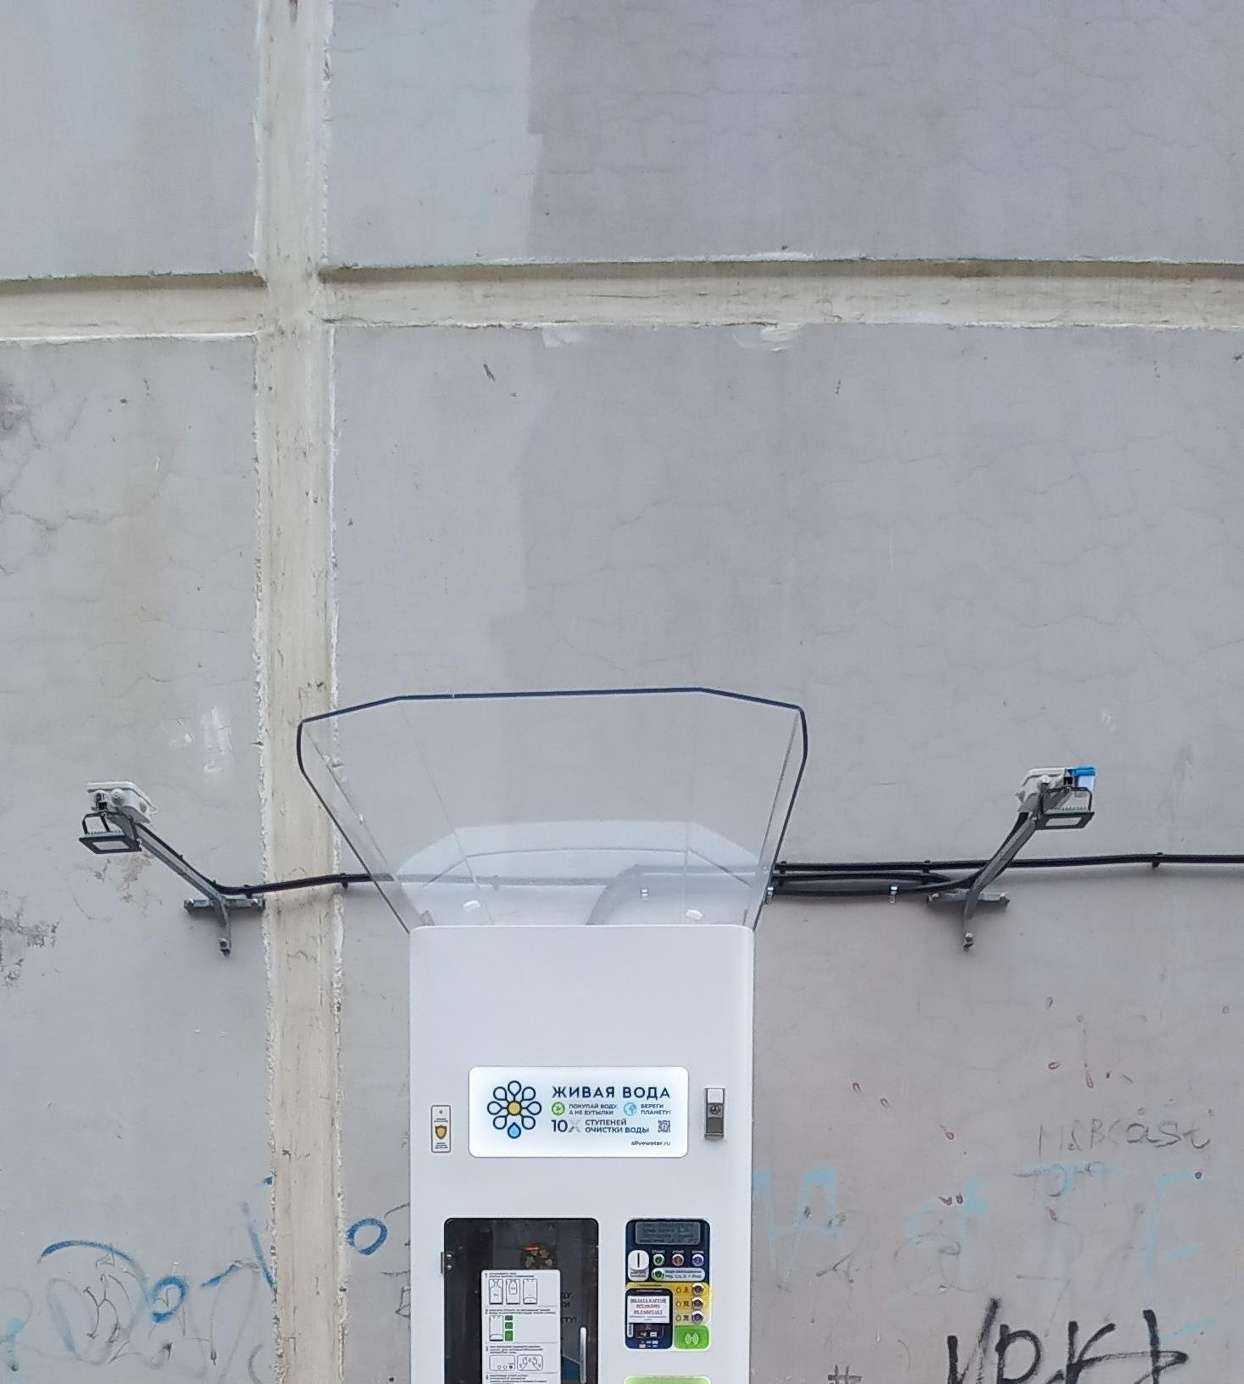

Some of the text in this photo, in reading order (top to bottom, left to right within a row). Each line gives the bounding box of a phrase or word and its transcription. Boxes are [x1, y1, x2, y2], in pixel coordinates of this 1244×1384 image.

[551, 1086, 670, 1100] ЖИВАЯ ВОДА
[624, 1126, 649, 1134] ВОДЫ
